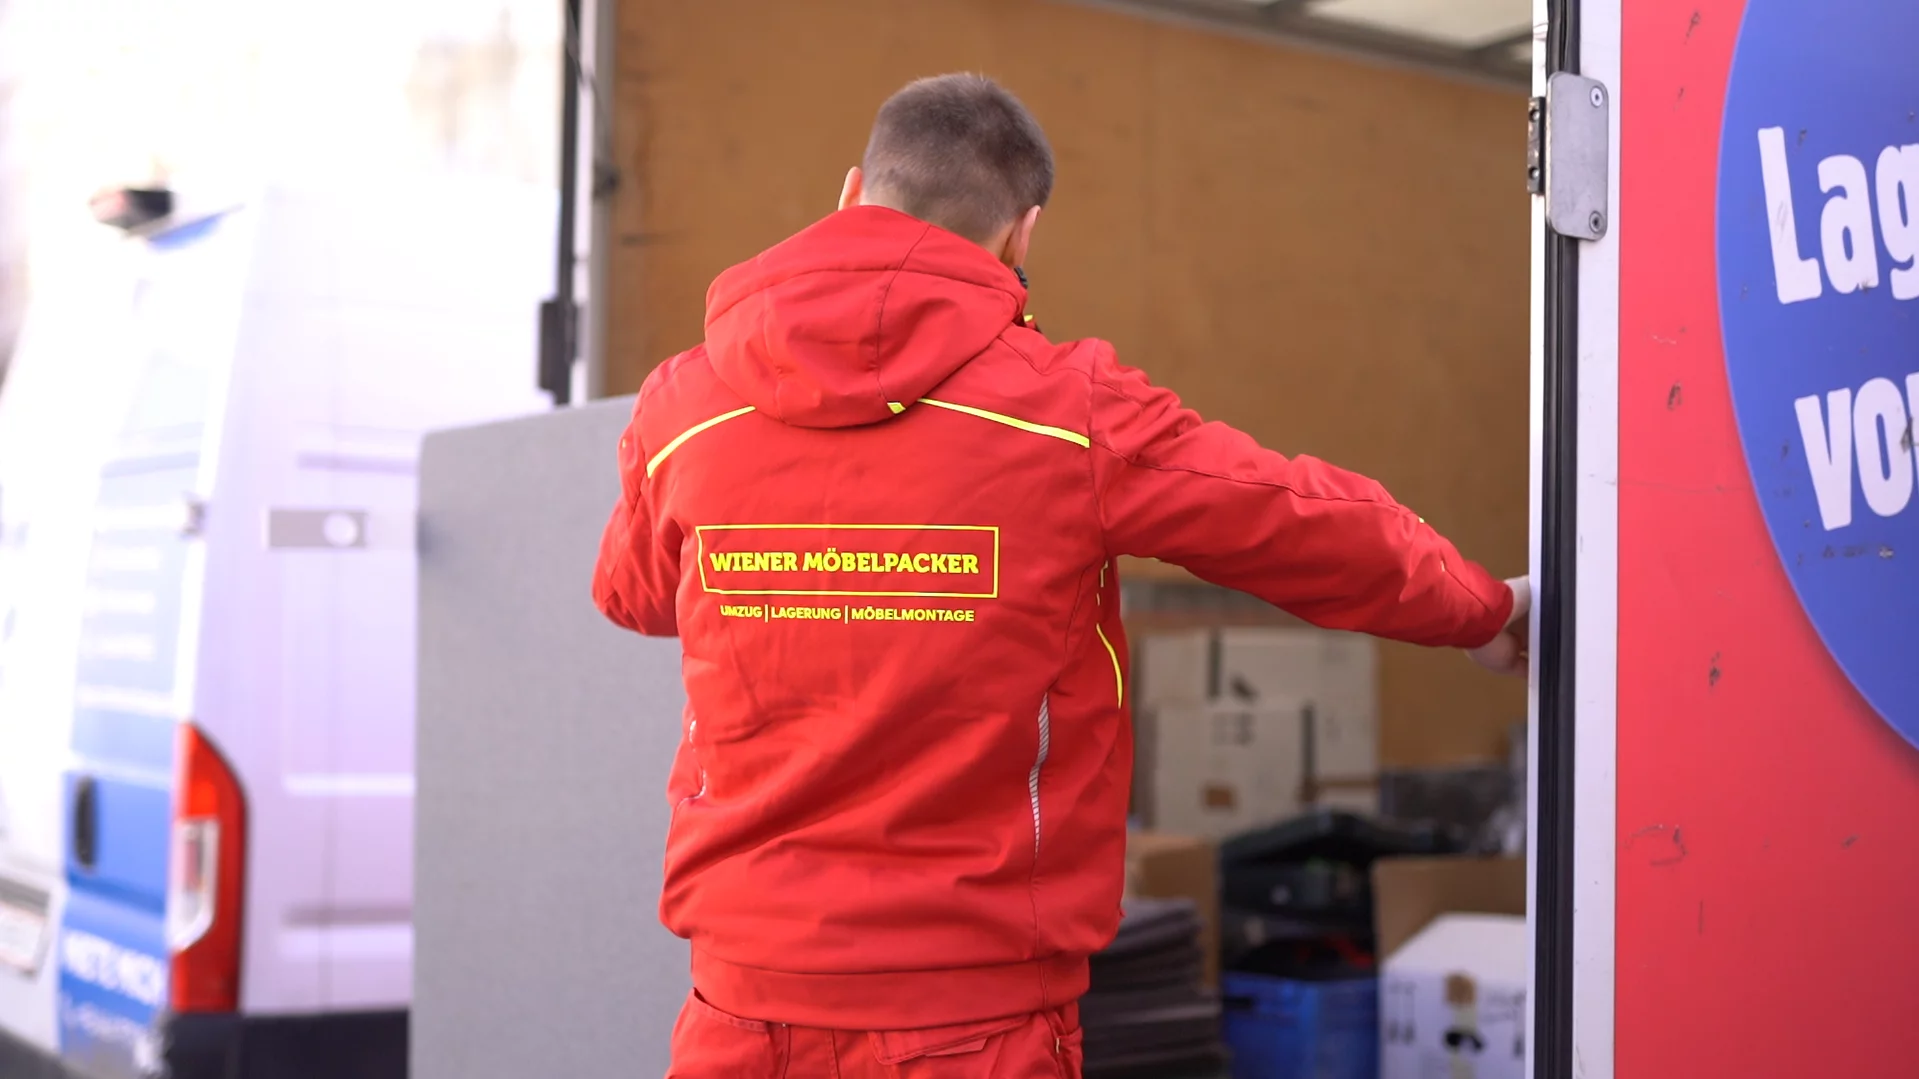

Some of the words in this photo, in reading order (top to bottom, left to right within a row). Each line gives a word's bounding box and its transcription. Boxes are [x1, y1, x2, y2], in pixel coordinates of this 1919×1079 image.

[1794, 372, 1919, 531] vo
[709, 551, 798, 572] WIENER
[802, 547, 979, 574] MÖBELPACKER
[720, 605, 763, 618] UMZUG
[771, 606, 842, 620] LAGERUNG
[851, 606, 975, 622] MÖBELMONTAGE
